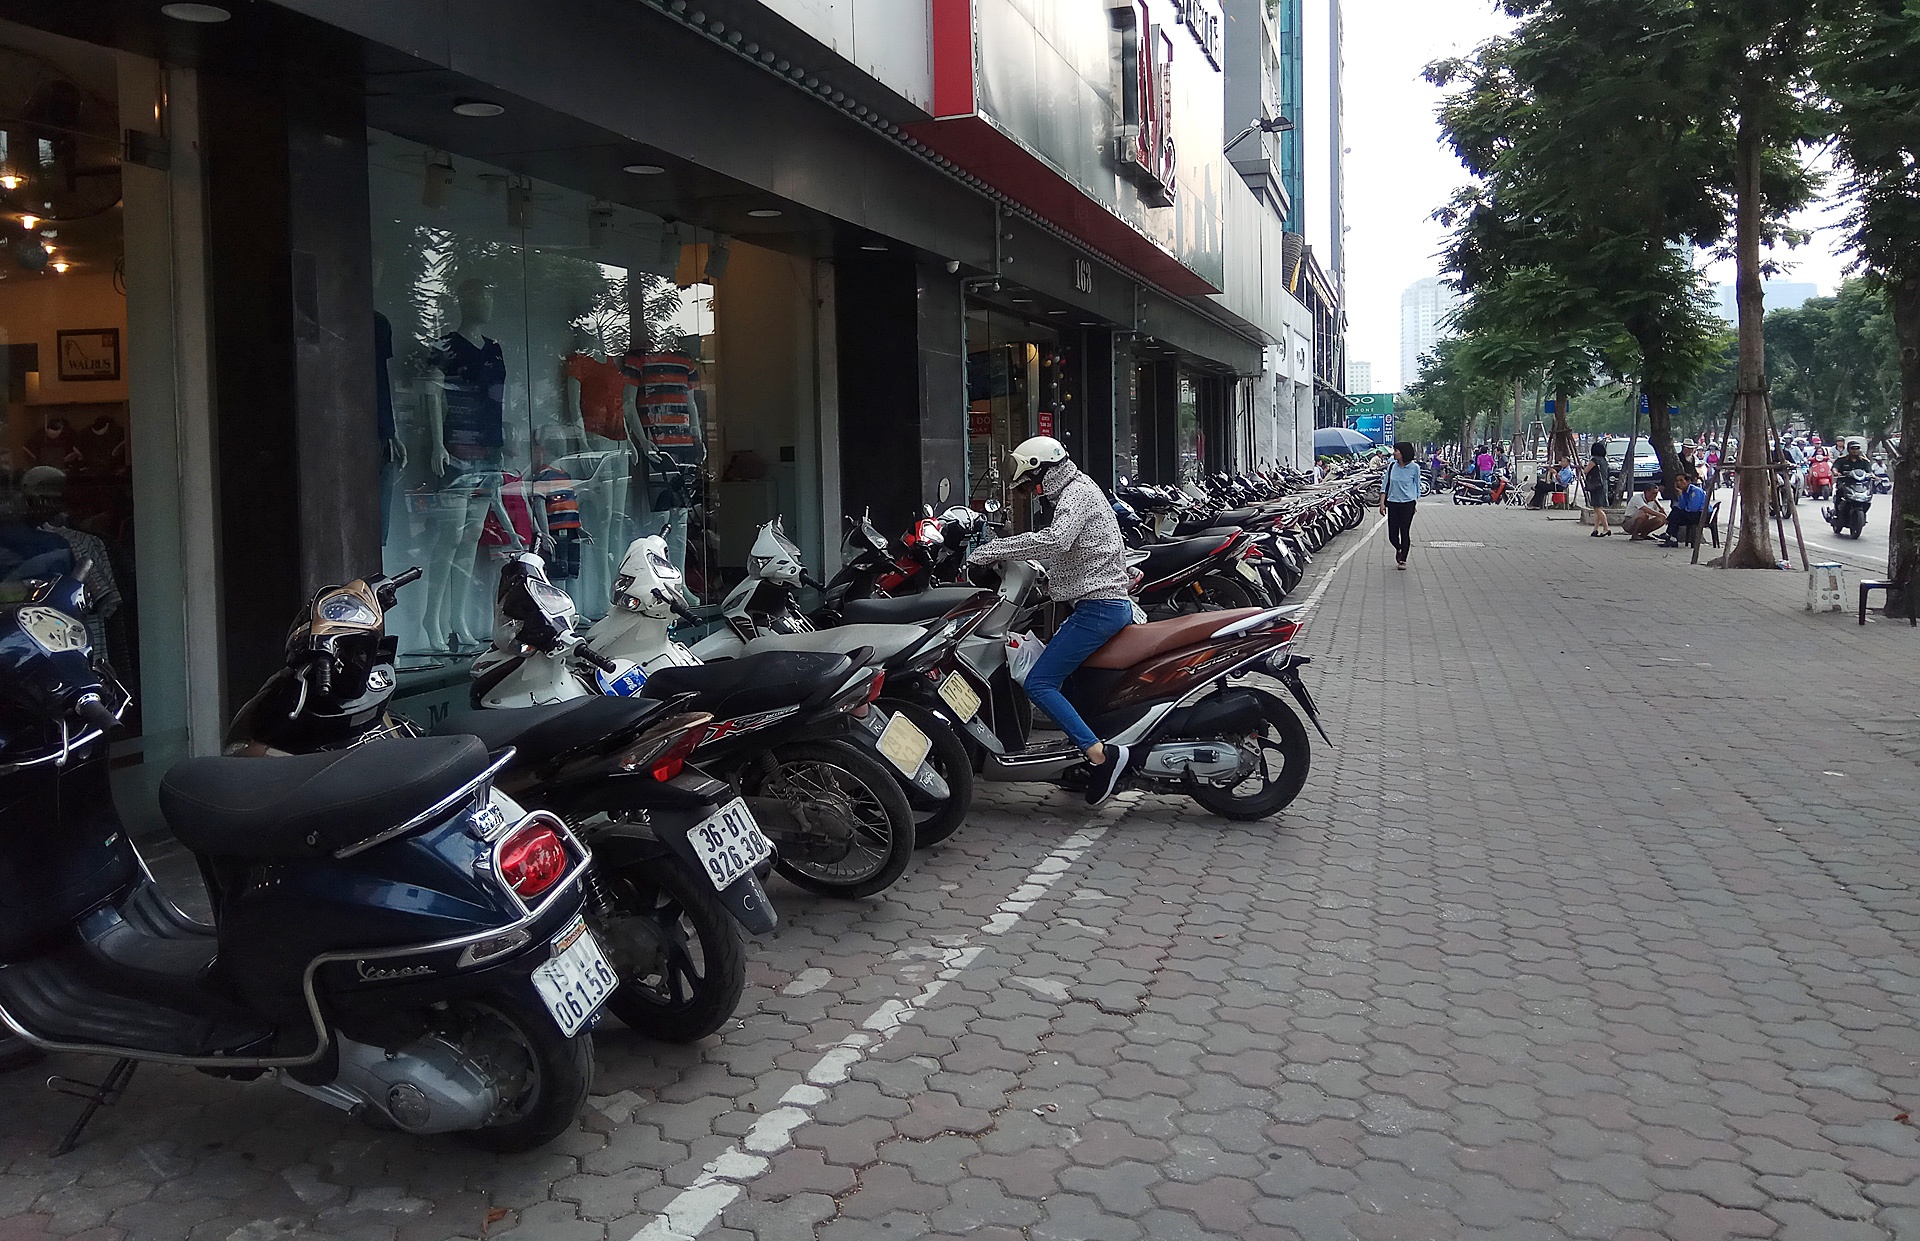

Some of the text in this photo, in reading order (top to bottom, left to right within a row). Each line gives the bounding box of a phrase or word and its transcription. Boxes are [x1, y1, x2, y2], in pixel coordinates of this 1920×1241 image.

[1075, 259, 1092, 293] 163
[699, 807, 748, 853] 36-B1
[709, 830, 764, 882] 926.38
[356, 959, 437, 982] Vespa
[556, 959, 612, 1029] 061.56
